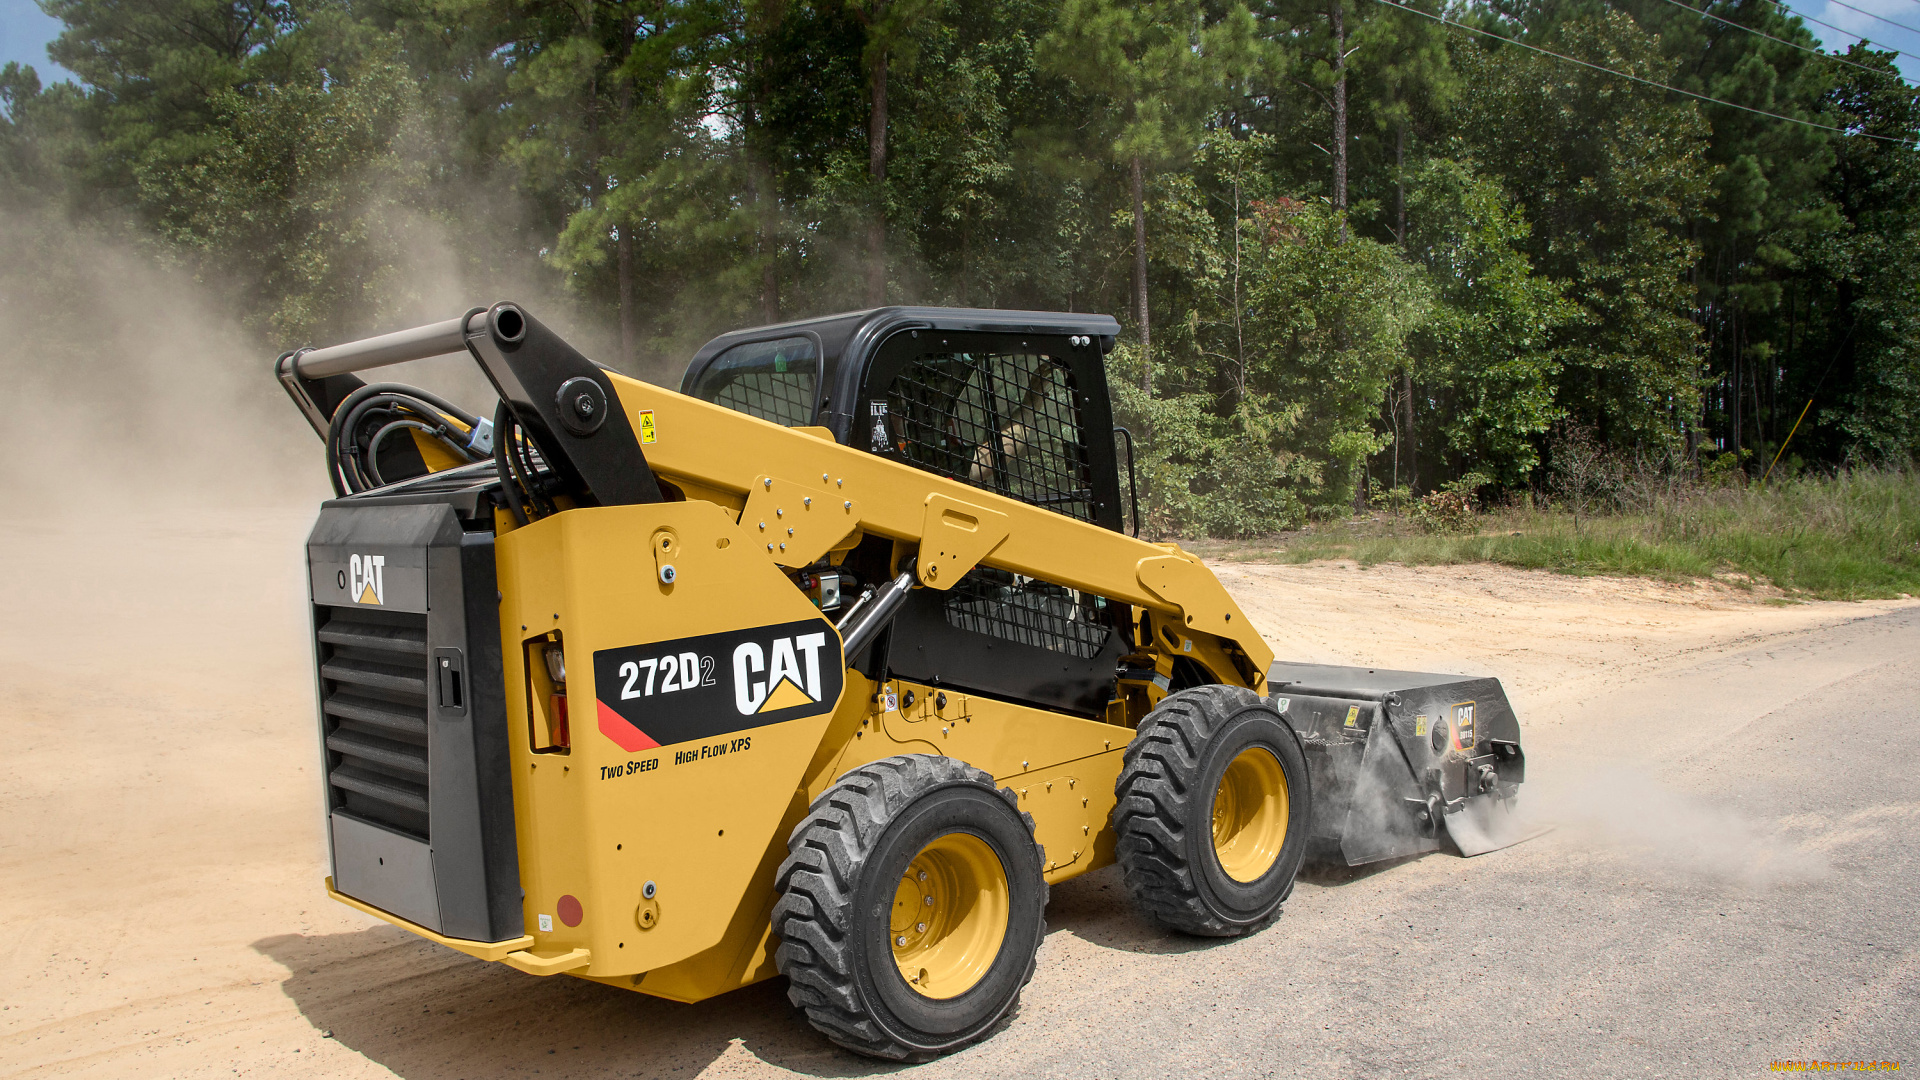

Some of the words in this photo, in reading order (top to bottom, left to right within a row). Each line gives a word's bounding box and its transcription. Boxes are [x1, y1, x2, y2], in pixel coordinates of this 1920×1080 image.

[350, 553, 385, 606] CAT
[619, 651, 717, 701] 272D2
[732, 631, 826, 716] CAT
[1458, 706, 1474, 727] CAT
[730, 736, 752, 753] XPS
